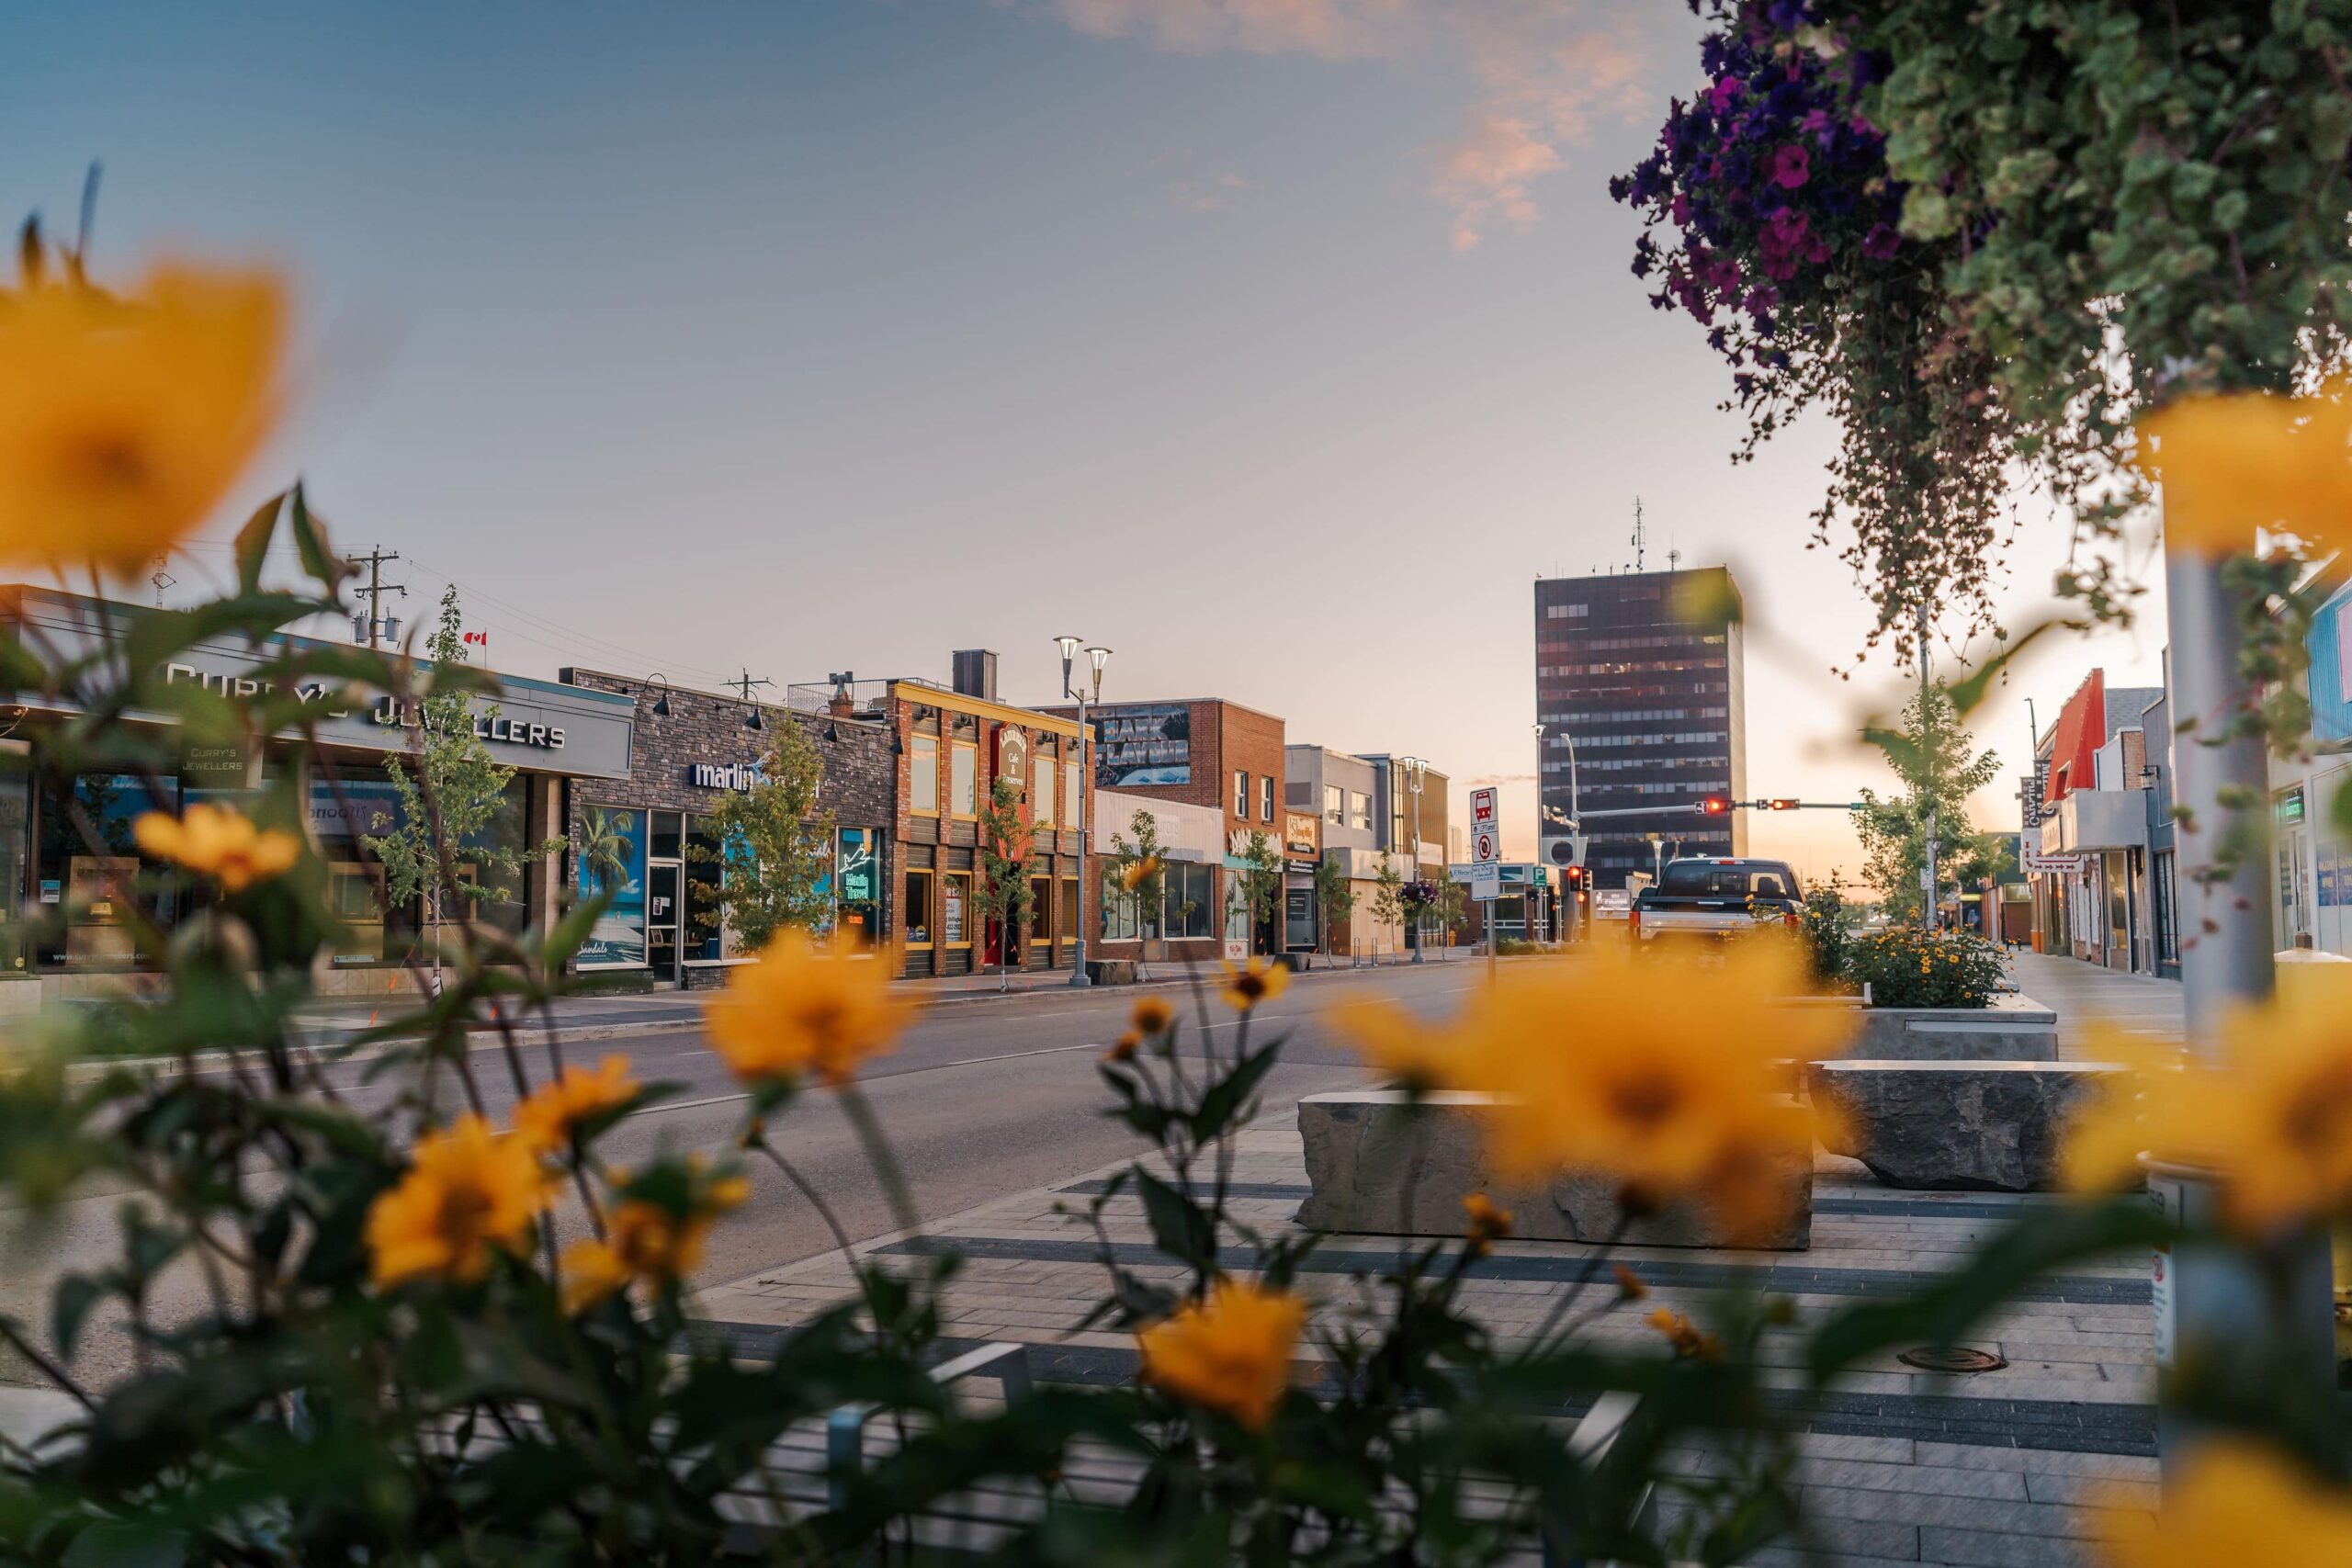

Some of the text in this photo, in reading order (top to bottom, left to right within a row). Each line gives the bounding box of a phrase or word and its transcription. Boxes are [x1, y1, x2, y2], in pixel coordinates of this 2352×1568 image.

[183, 761, 243, 771] JEWELLERS
[695, 763, 754, 791] marlin
[1535, 868, 1545, 880] P
[845, 886, 869, 900] Travel
